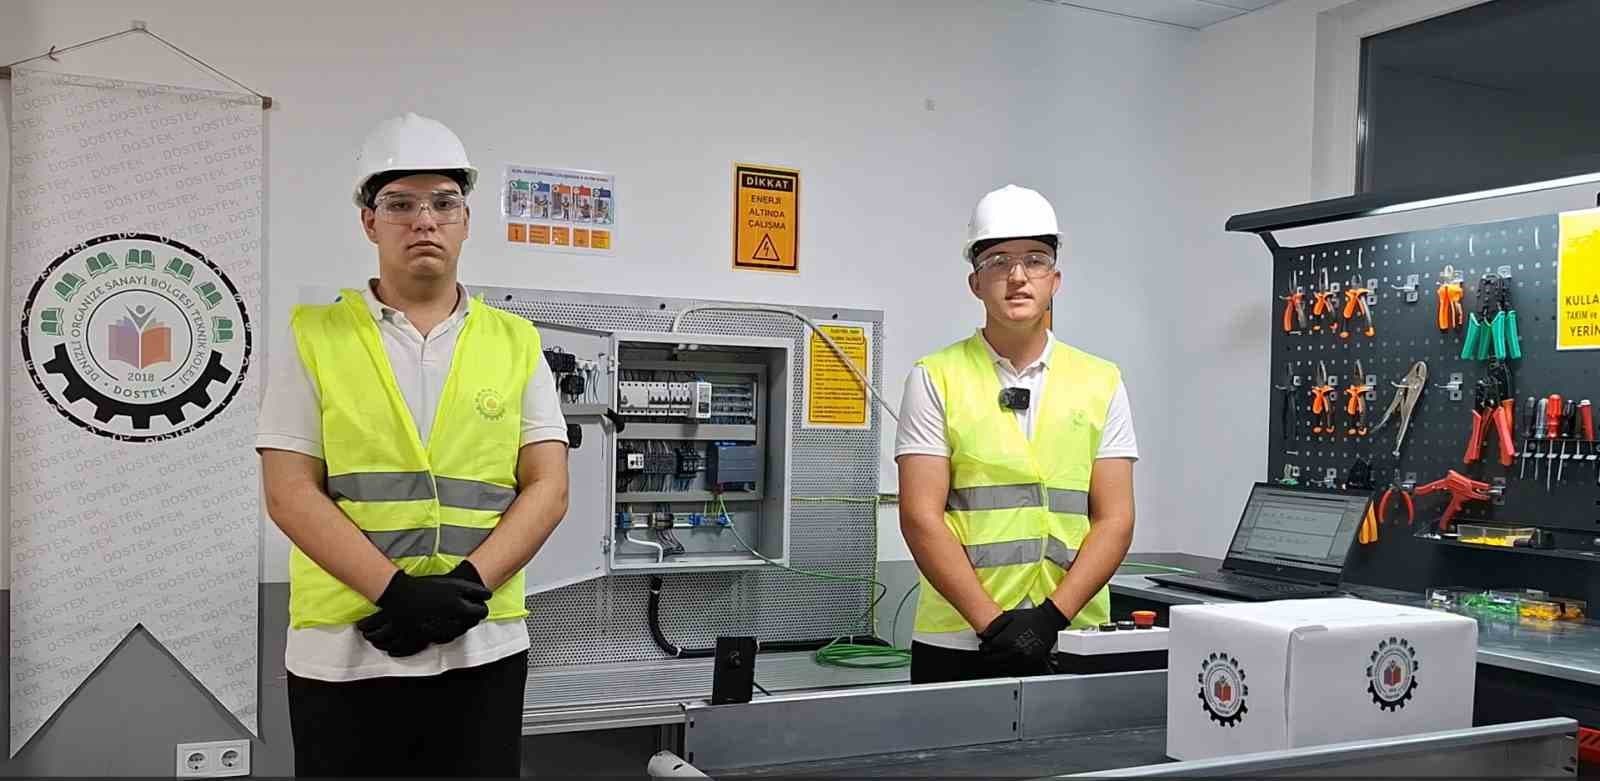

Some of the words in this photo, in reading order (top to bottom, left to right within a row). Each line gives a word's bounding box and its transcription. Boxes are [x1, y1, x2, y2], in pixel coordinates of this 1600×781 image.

[749, 208, 785, 217] ALTINDA
[128, 372, 154, 382] 2018
[113, 385, 167, 399] DOSTEK
